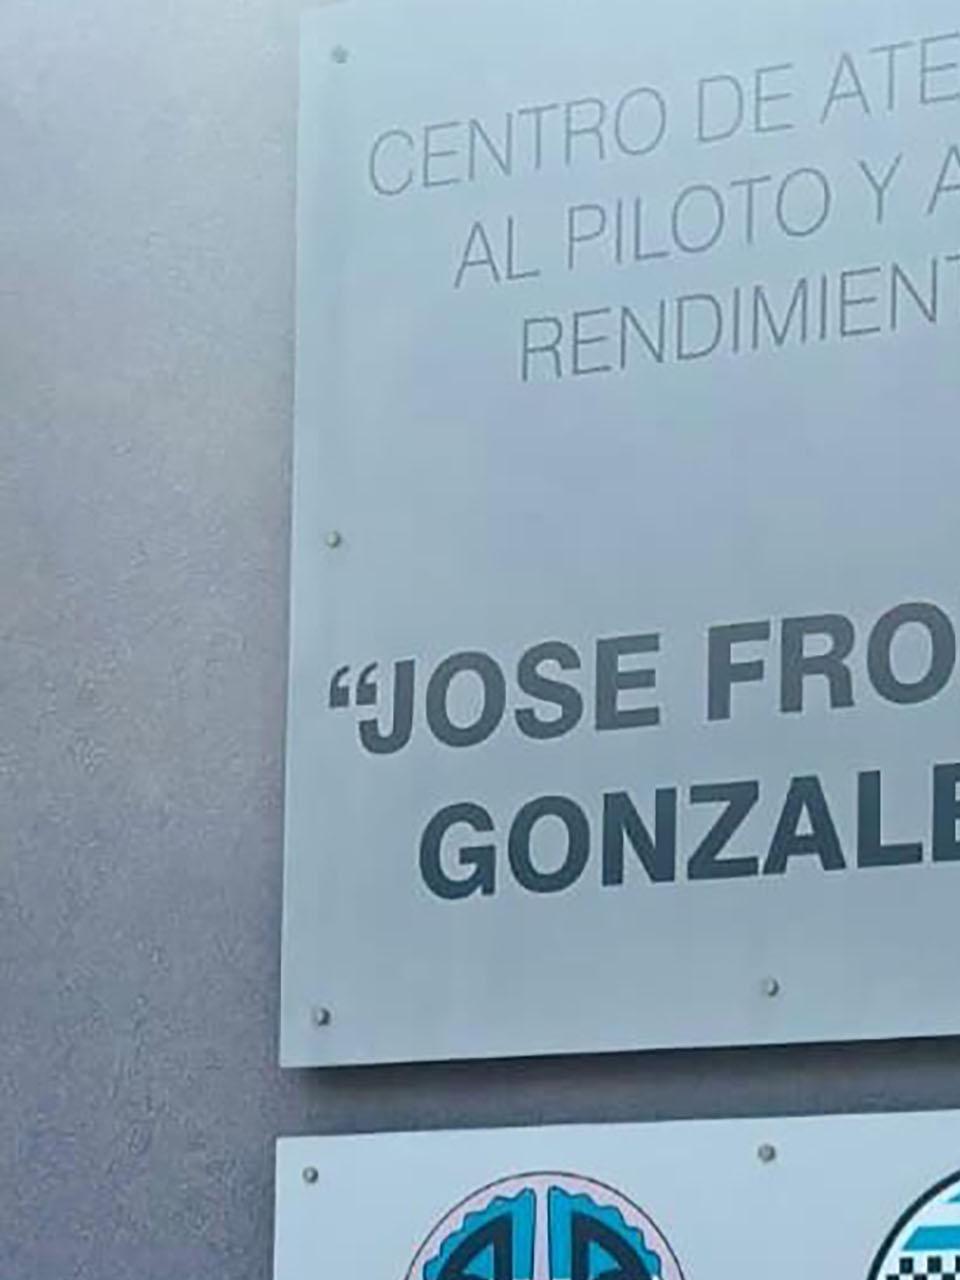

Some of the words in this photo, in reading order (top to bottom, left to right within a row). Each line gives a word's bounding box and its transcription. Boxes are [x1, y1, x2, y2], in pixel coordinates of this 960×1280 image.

[368, 86, 667, 198] CENTRO
[696, 62, 795, 144] DE
[455, 215, 541, 289] AL
[568, 167, 831, 268] PILOTO
[857, 154, 903, 223] Y
